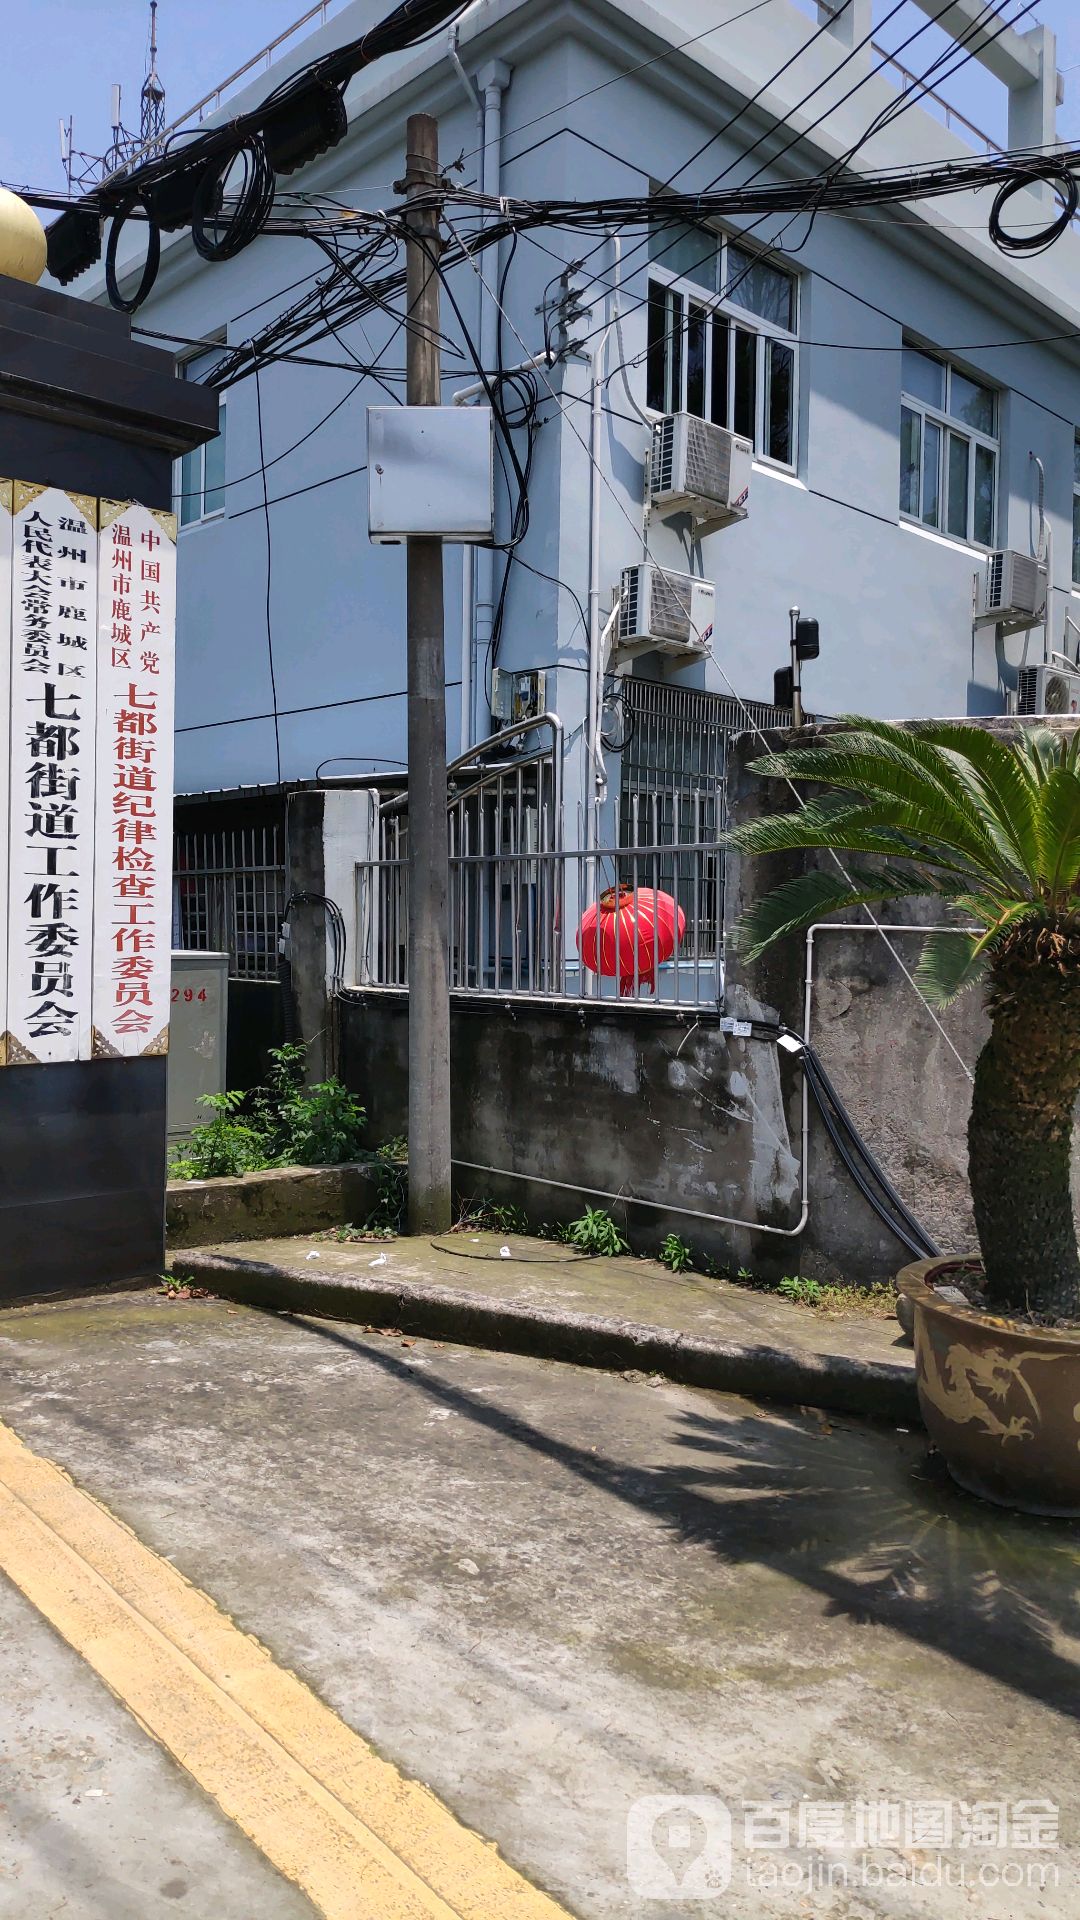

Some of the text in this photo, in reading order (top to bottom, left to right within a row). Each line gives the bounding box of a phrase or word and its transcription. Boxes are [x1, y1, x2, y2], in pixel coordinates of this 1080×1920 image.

[20, 510, 54, 674] 人民代表大会常务委员会
[56, 515, 88, 678] 温州市鹿城区
[110, 522, 132, 669] 温州市鹿城区
[139, 529, 161, 675] 中国共产党
[23, 682, 83, 1038] 七都街道工作委员会
[110, 682, 158, 1034] 七都街道纪律检查工作委员会
[170, 988, 208, 1003] 294
